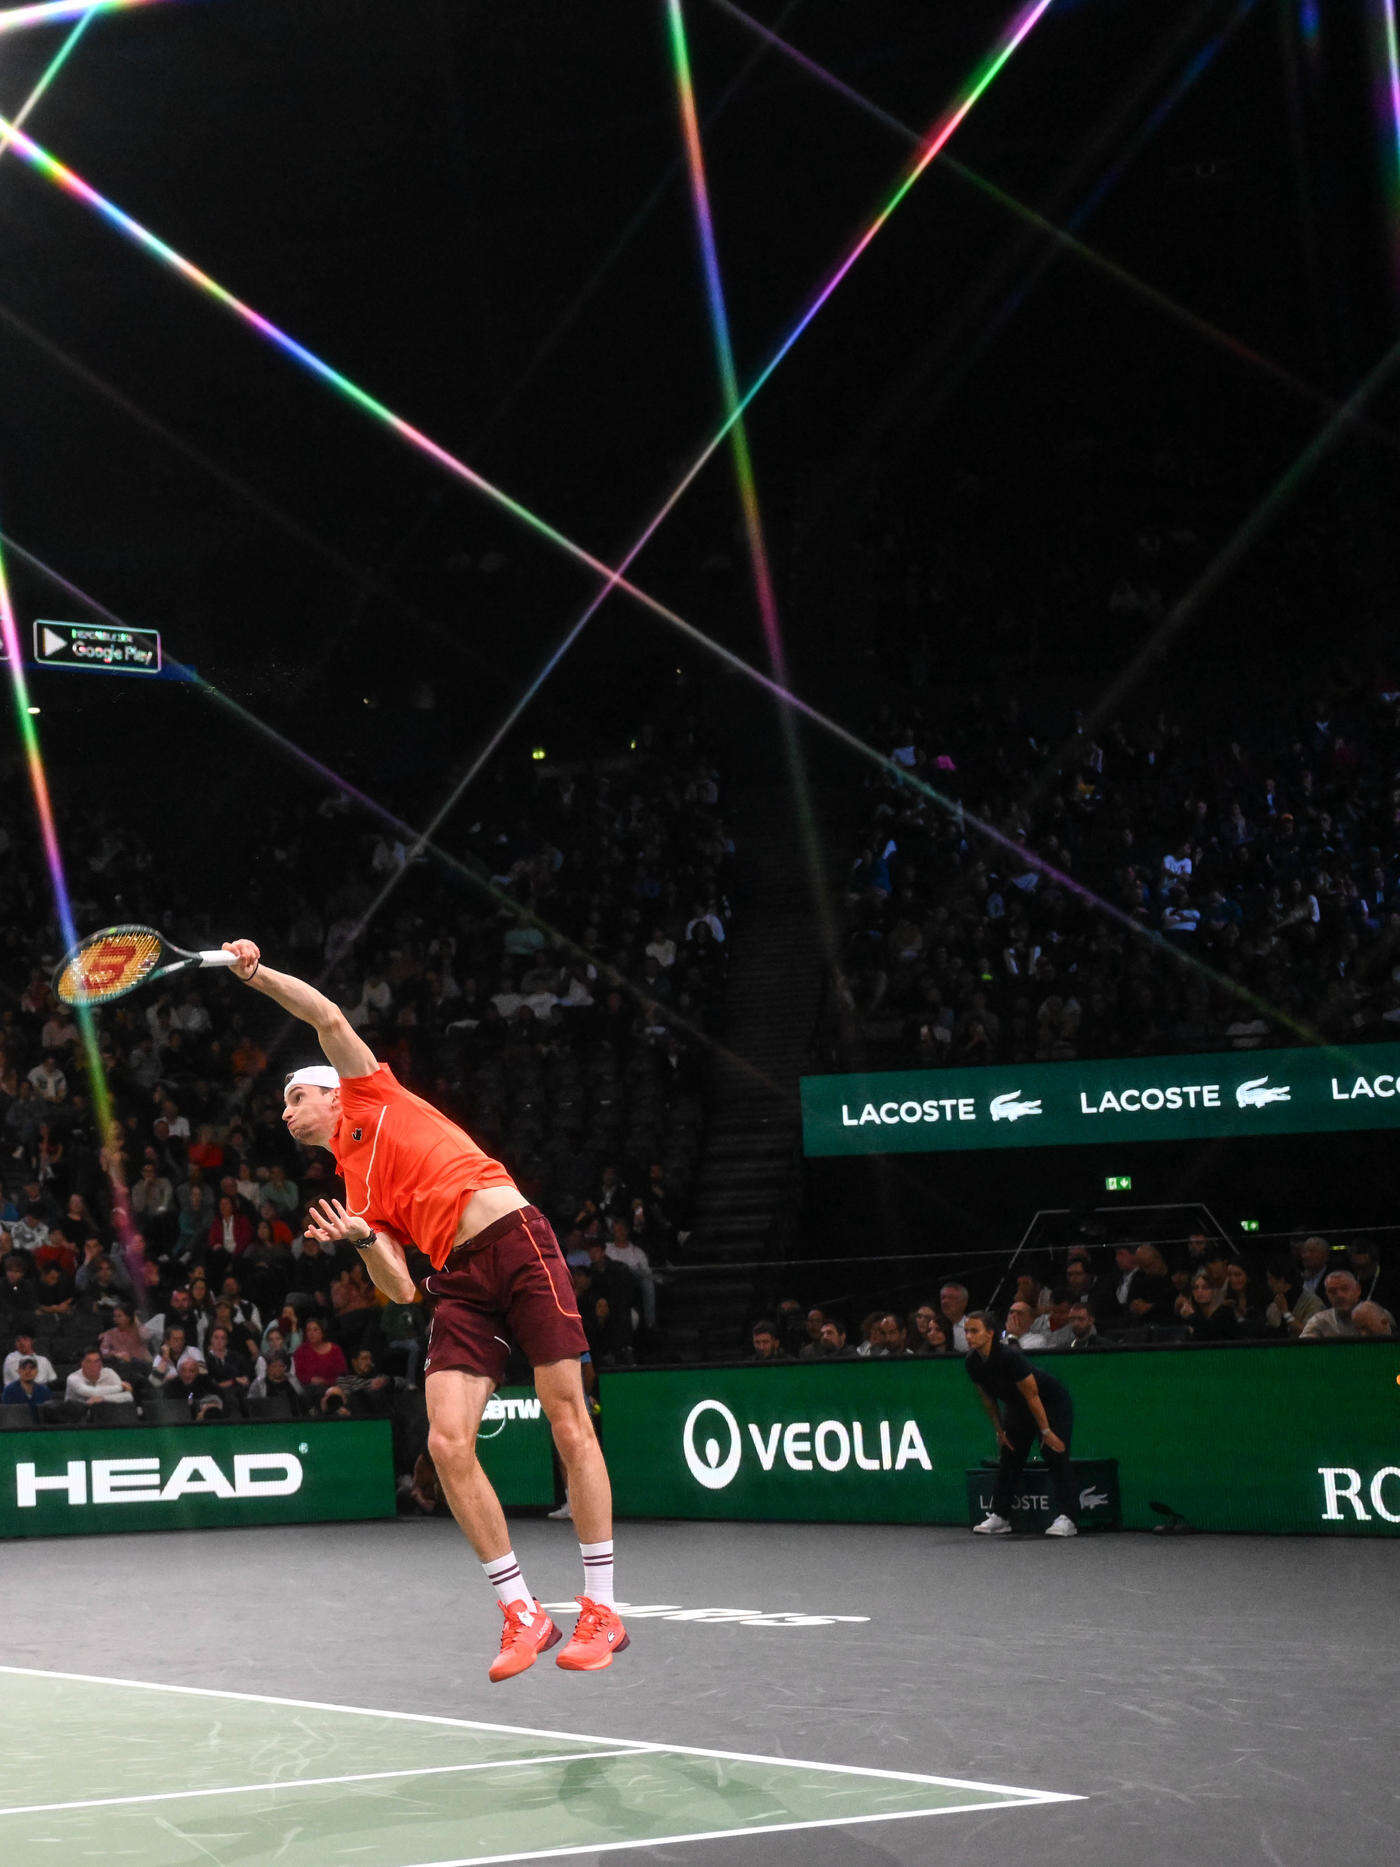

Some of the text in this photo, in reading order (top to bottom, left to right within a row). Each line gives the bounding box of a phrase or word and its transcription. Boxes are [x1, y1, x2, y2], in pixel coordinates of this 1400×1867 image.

[72, 641, 153, 665] Google Play
[1081, 1085, 1220, 1114] LACOSTE
[1332, 1075, 1400, 1099] LAC
[843, 1098, 975, 1126] LACOSTE
[748, 1420, 932, 1471] VEOLIA
[16, 1453, 303, 1507] HEAD
[980, 1495, 1049, 1510] LOSTE
